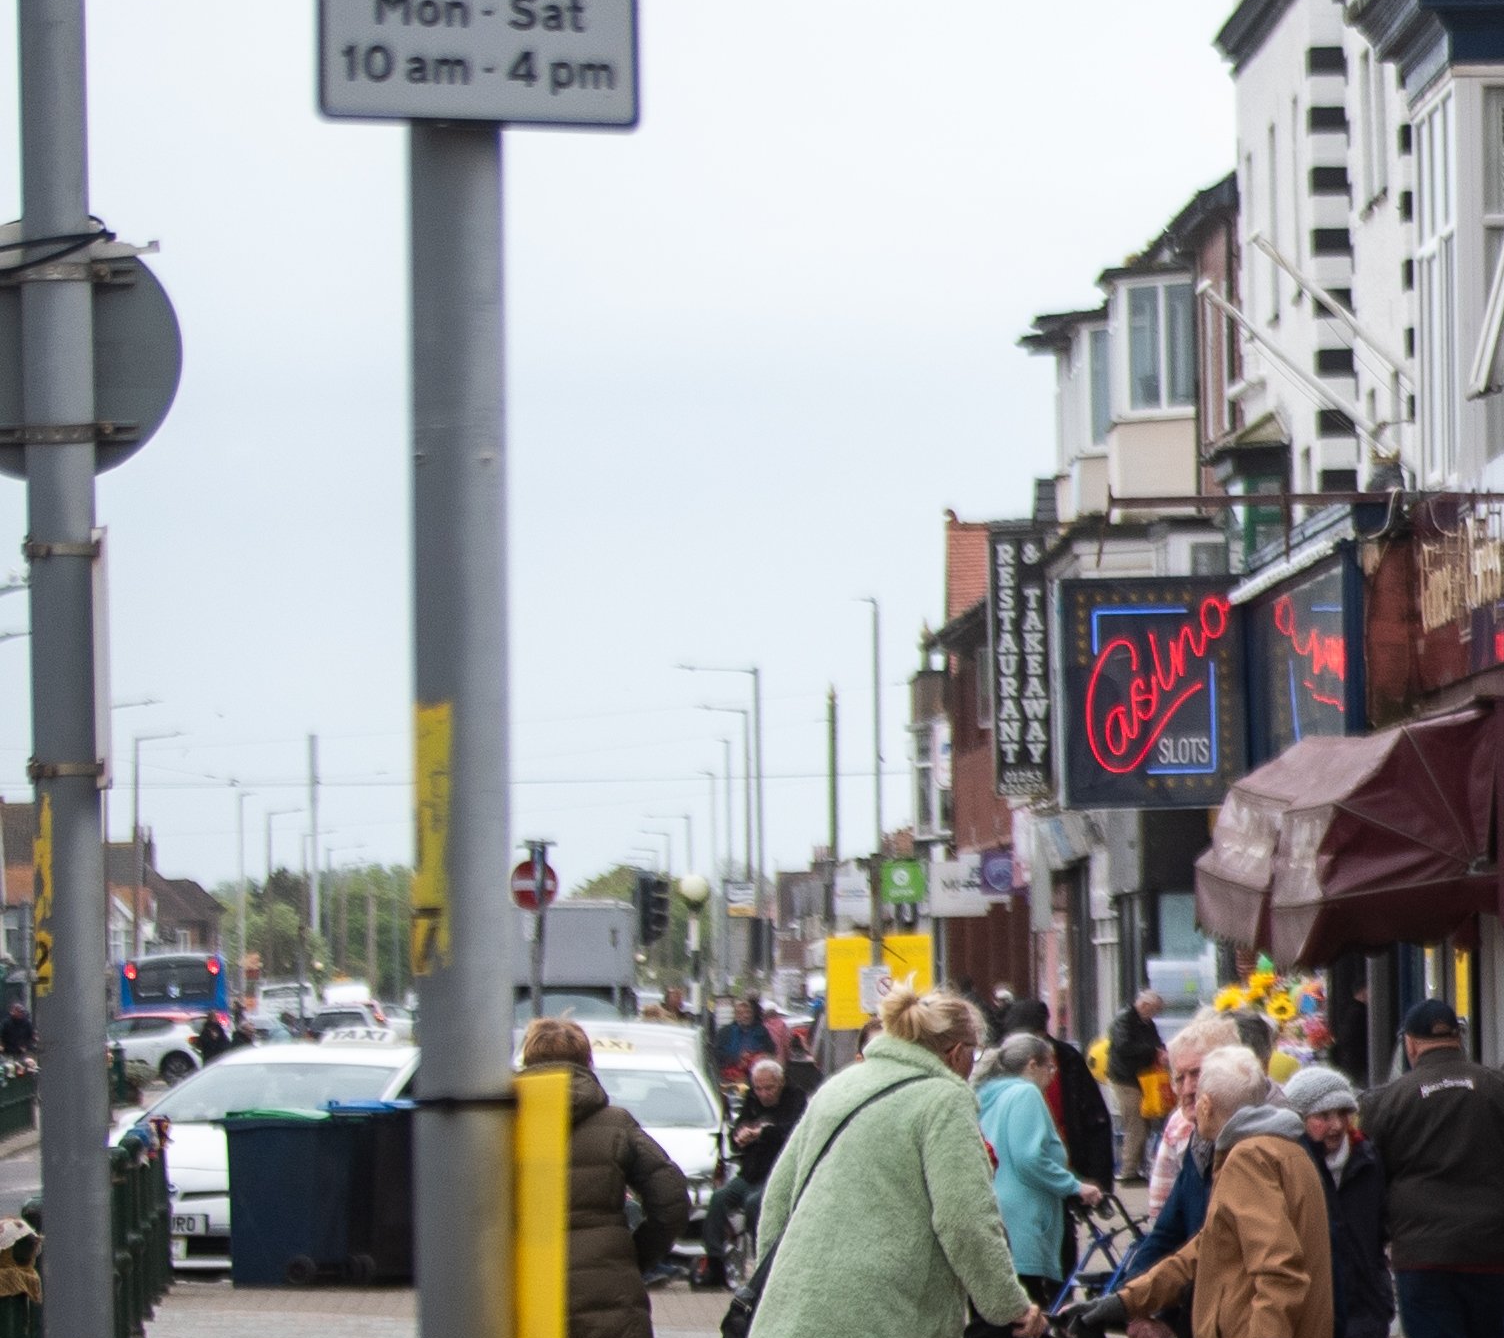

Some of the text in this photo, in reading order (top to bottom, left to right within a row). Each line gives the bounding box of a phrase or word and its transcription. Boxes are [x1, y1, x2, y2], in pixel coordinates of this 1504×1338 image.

[341, 44, 394, 83] 10
[405, 56, 471, 86] am
[507, 50, 539, 88] 4
[550, 58, 618, 96] pm
[1021, 542, 1041, 565] &
[995, 543, 1021, 764] RESTAURANT
[1021, 587, 1050, 764] TAKEAWAY
[1085, 593, 1231, 774] Casino
[1158, 737, 1210, 764] SLOTS
[331, 1028, 388, 1042] TAXI
[593, 1038, 635, 1051] AXI
